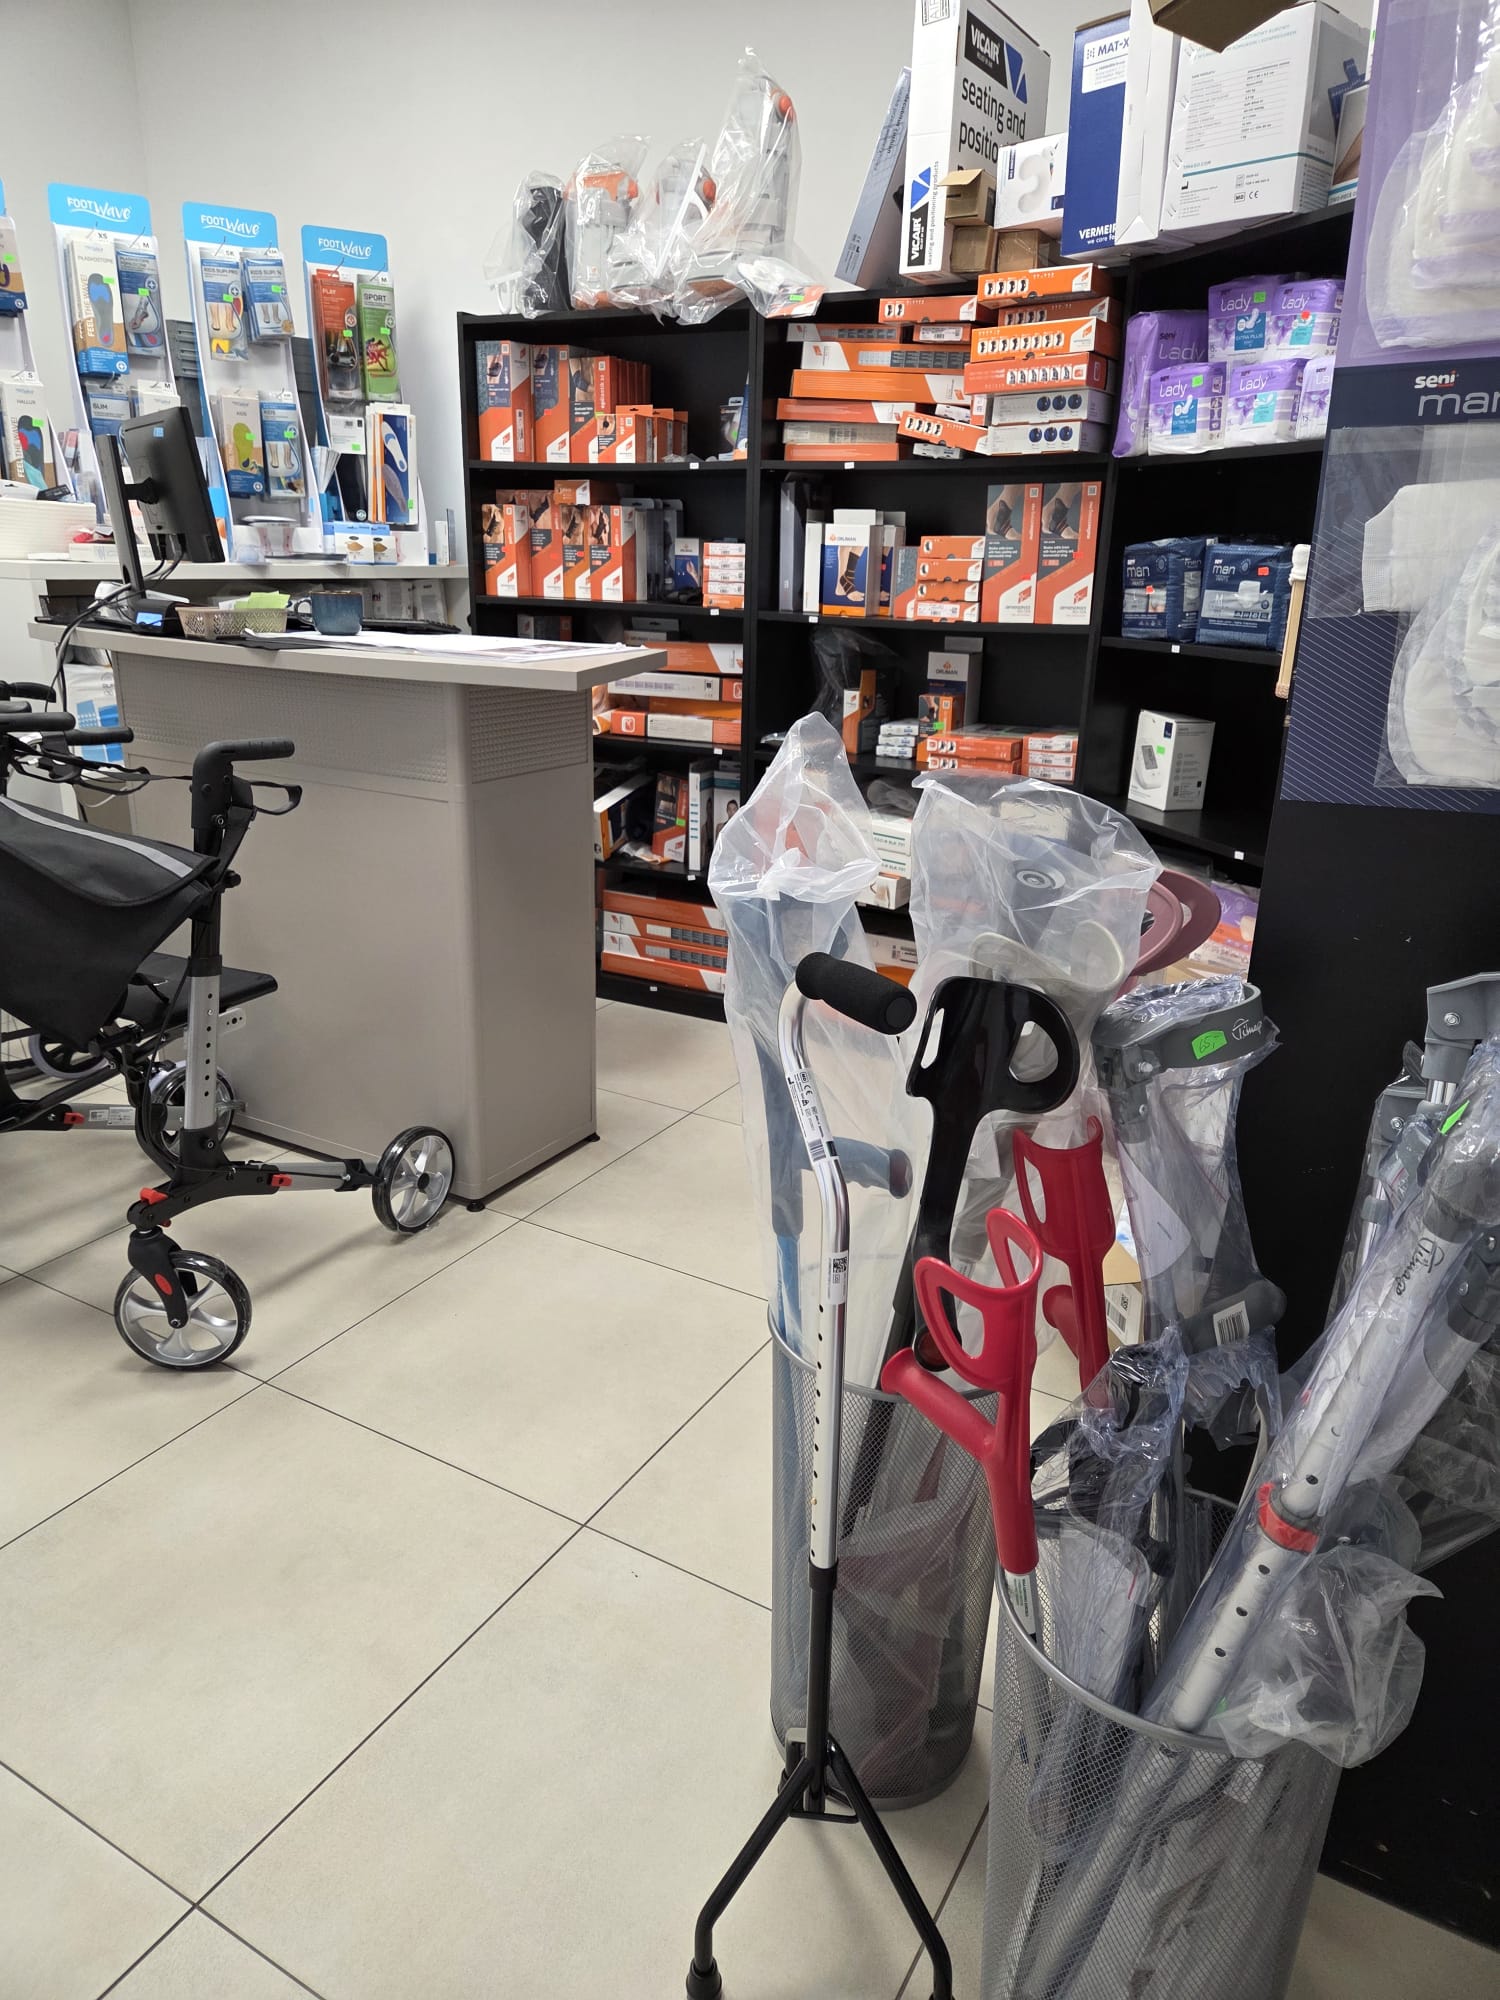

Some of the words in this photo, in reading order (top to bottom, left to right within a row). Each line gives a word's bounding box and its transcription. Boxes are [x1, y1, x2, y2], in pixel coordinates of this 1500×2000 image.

[971, 24, 1000, 65] VICAIR
[1097, 36, 1129, 57] MAT-X
[961, 77, 1005, 134] seating
[1006, 111, 1026, 140] and
[958, 120, 999, 164] positio
[98, 232, 108, 240] XS
[910, 217, 922, 261] VICAIR
[363, 292, 387, 302] SPORT
[1414, 369, 1457, 389] seni
[1126, 565, 1150, 578] man
[1212, 564, 1236, 576] man
